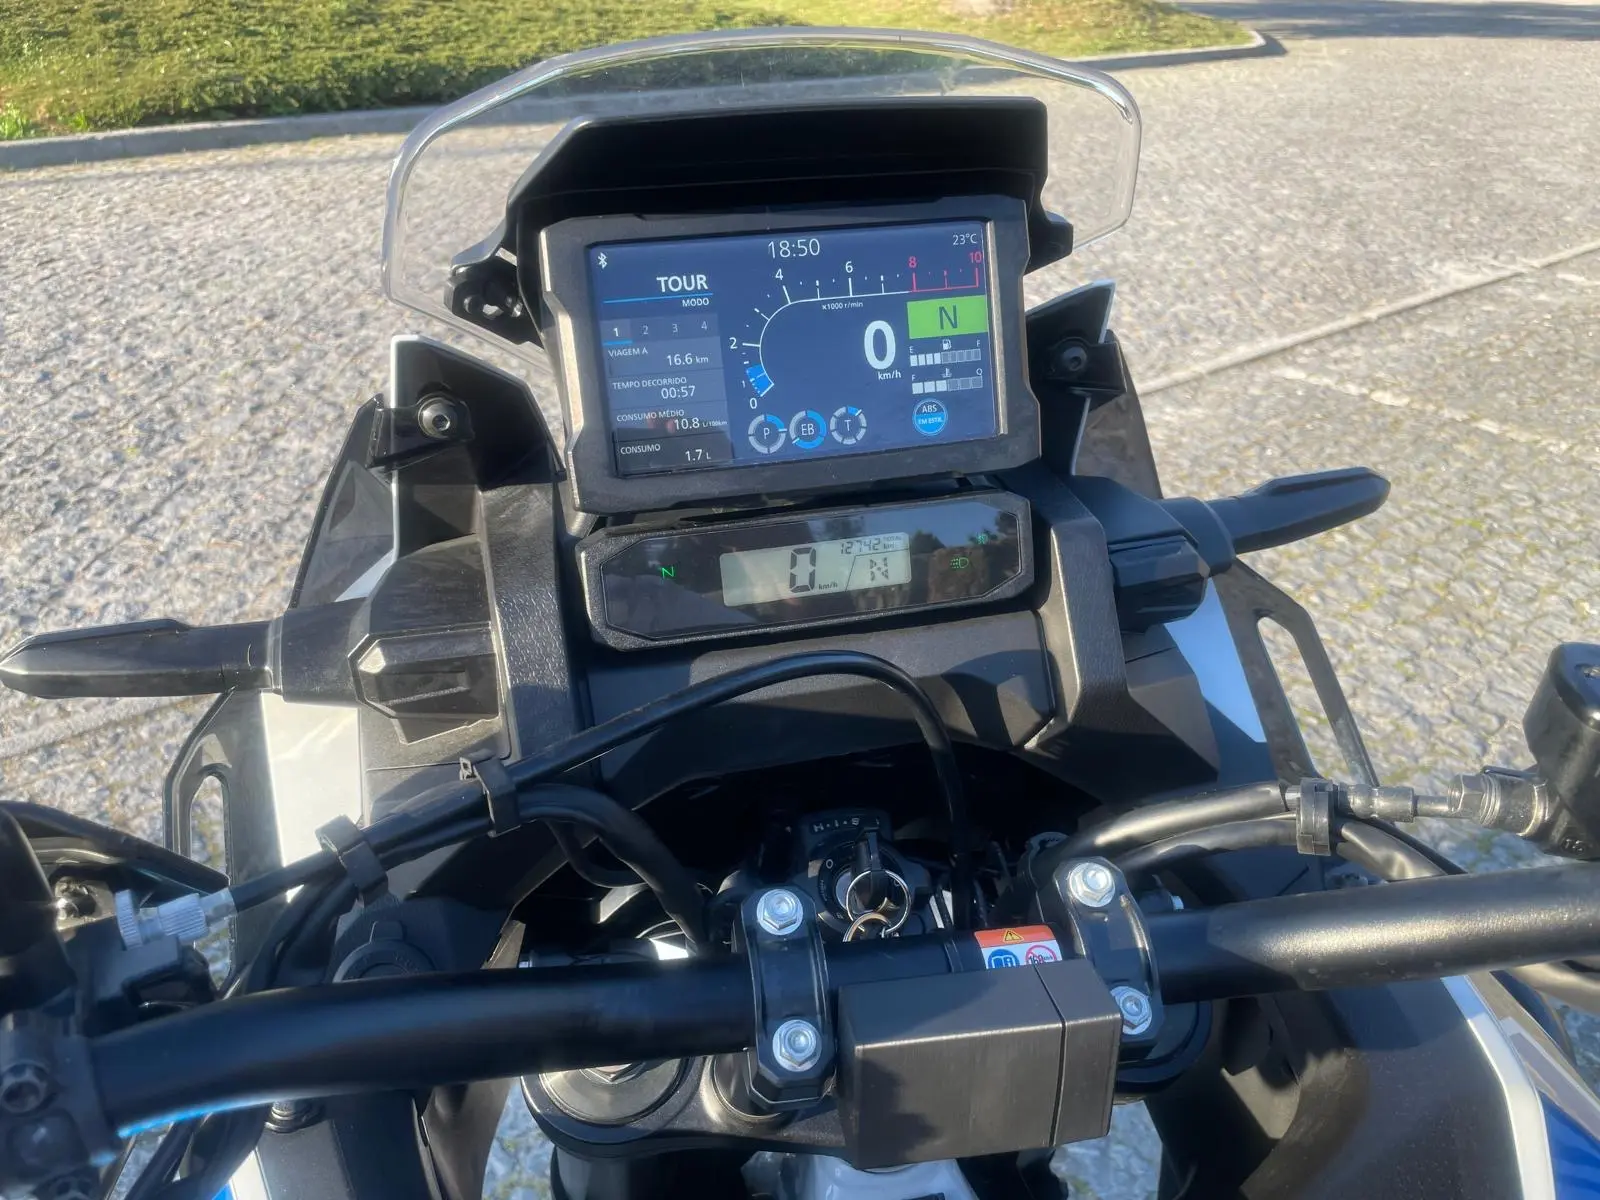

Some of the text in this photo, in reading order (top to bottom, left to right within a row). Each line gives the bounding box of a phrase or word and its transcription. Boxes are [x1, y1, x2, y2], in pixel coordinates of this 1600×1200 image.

[952, 233, 977, 245] 23°C
[768, 239, 820, 259] 18:50
[908, 256, 917, 268] 8
[969, 251, 982, 263] 10
[845, 261, 853, 273] 6
[775, 269, 783, 281] 4
[656, 274, 708, 293] TOUR
[682, 298, 709, 307] MODO
[938, 305, 958, 330] N
[613, 321, 708, 337] 1 2 3 4
[729, 337, 738, 350] 2
[864, 320, 896, 370] 0
[608, 347, 648, 358] VIAGEM A
[667, 353, 709, 366] 16.6 km
[877, 370, 901, 380] km/h
[612, 376, 687, 390] TEMPO DECORRIDO
[661, 385, 696, 399] 00:57
[749, 398, 758, 410] 0
[922, 404, 938, 413] ABS
[616, 408, 685, 422] CONSUMO MÉDIO
[674, 417, 700, 431] 10.8
[801, 423, 815, 436] EB
[844, 419, 851, 432] T
[763, 427, 770, 439] P
[620, 443, 661, 455] CONSUMO
[685, 449, 712, 462] 1.7 L
[661, 566, 675, 579] N
[789, 547, 816, 593] 0
